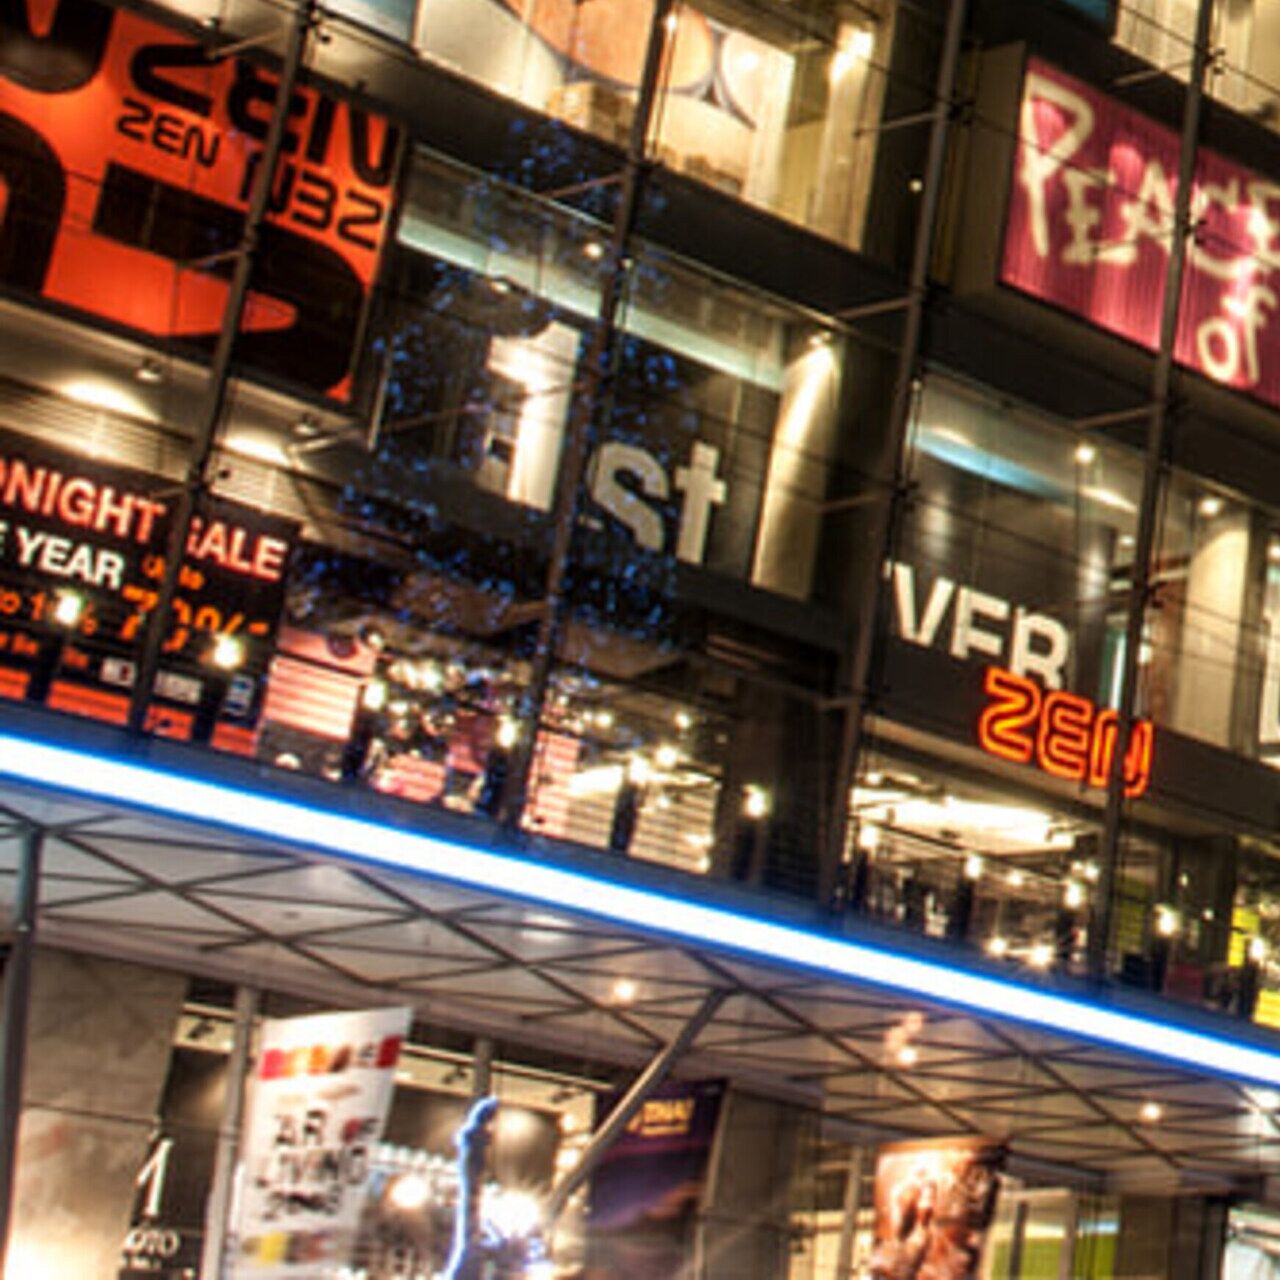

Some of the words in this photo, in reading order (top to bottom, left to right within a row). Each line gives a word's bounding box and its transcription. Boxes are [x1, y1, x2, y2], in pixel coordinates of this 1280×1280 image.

[116, 95, 221, 168] ZEN
[0, 460, 166, 543] NIGHT
[16, 526, 125, 591] YEAR
[883, 558, 1069, 691] VER
[978, 665, 1154, 798] ZEN
